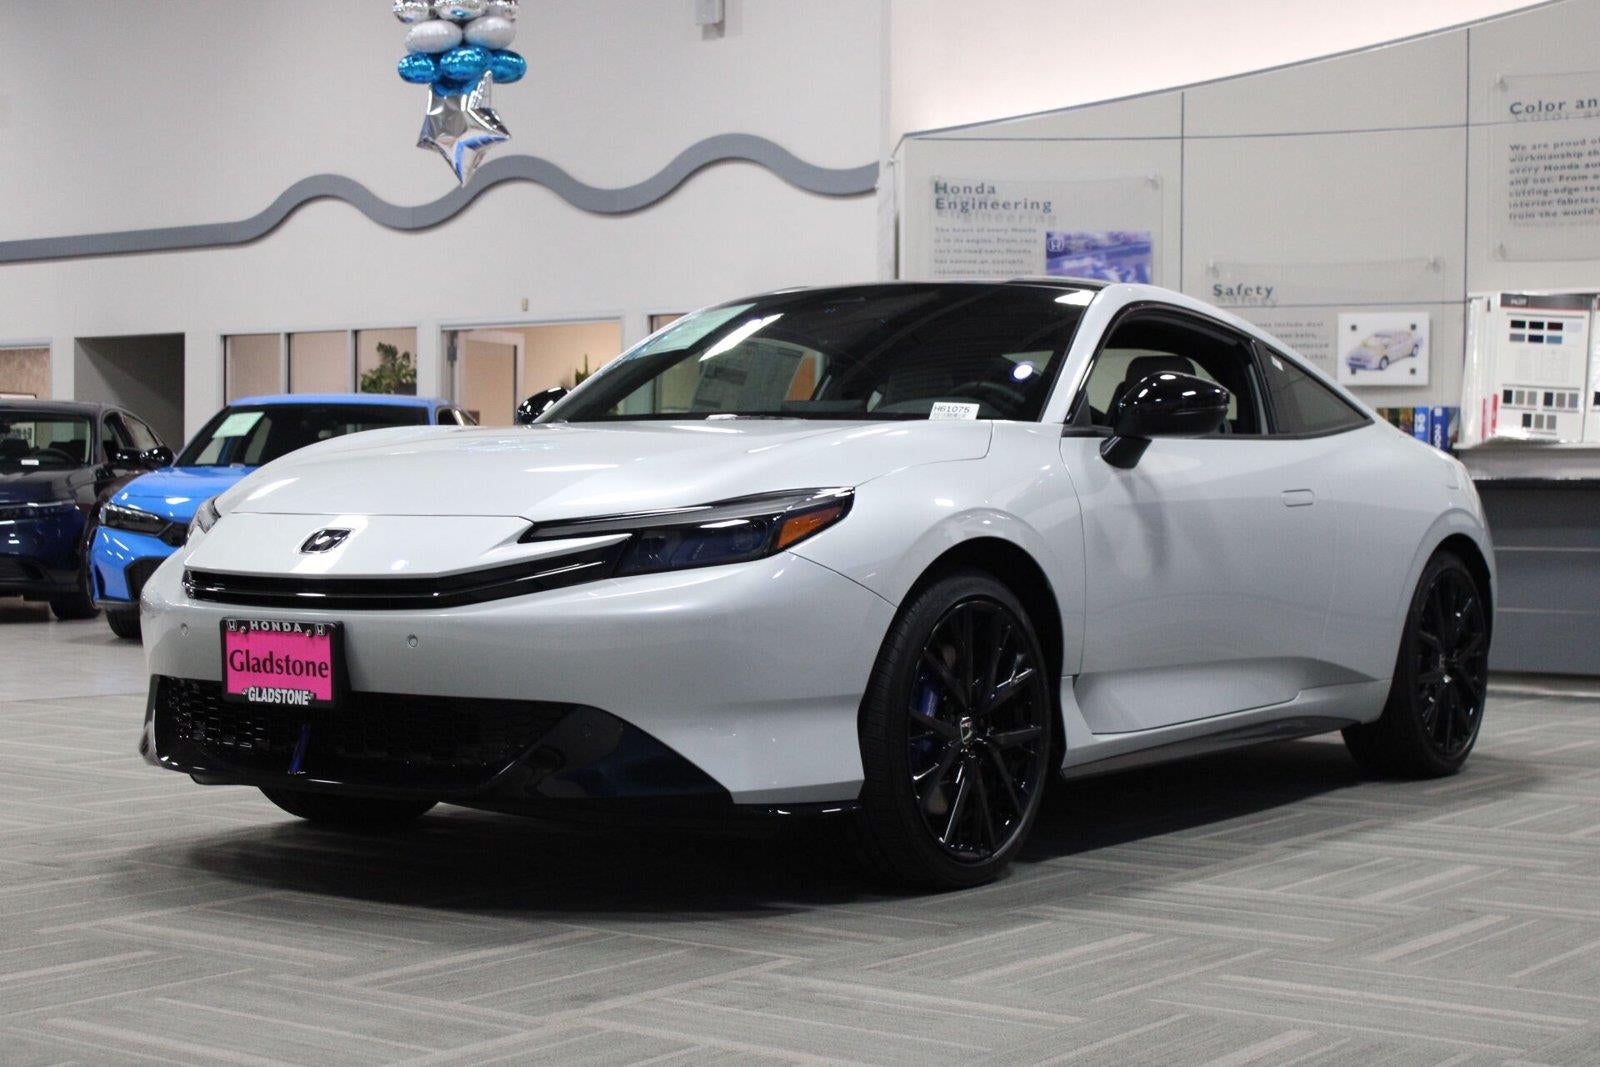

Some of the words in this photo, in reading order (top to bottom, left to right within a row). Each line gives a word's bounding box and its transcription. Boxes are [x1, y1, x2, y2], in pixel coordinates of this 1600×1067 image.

[1510, 100, 1566, 115] Color
[1554, 138, 1586, 150] proud
[1544, 164, 1580, 172] Honda
[934, 181, 996, 194] Honda
[935, 198, 1052, 214] Engineering
[1213, 284, 1274, 298] Safety
[250, 620, 302, 632] HONDA
[229, 649, 329, 678] Gladstone
[248, 686, 309, 705] GLADSTONE
